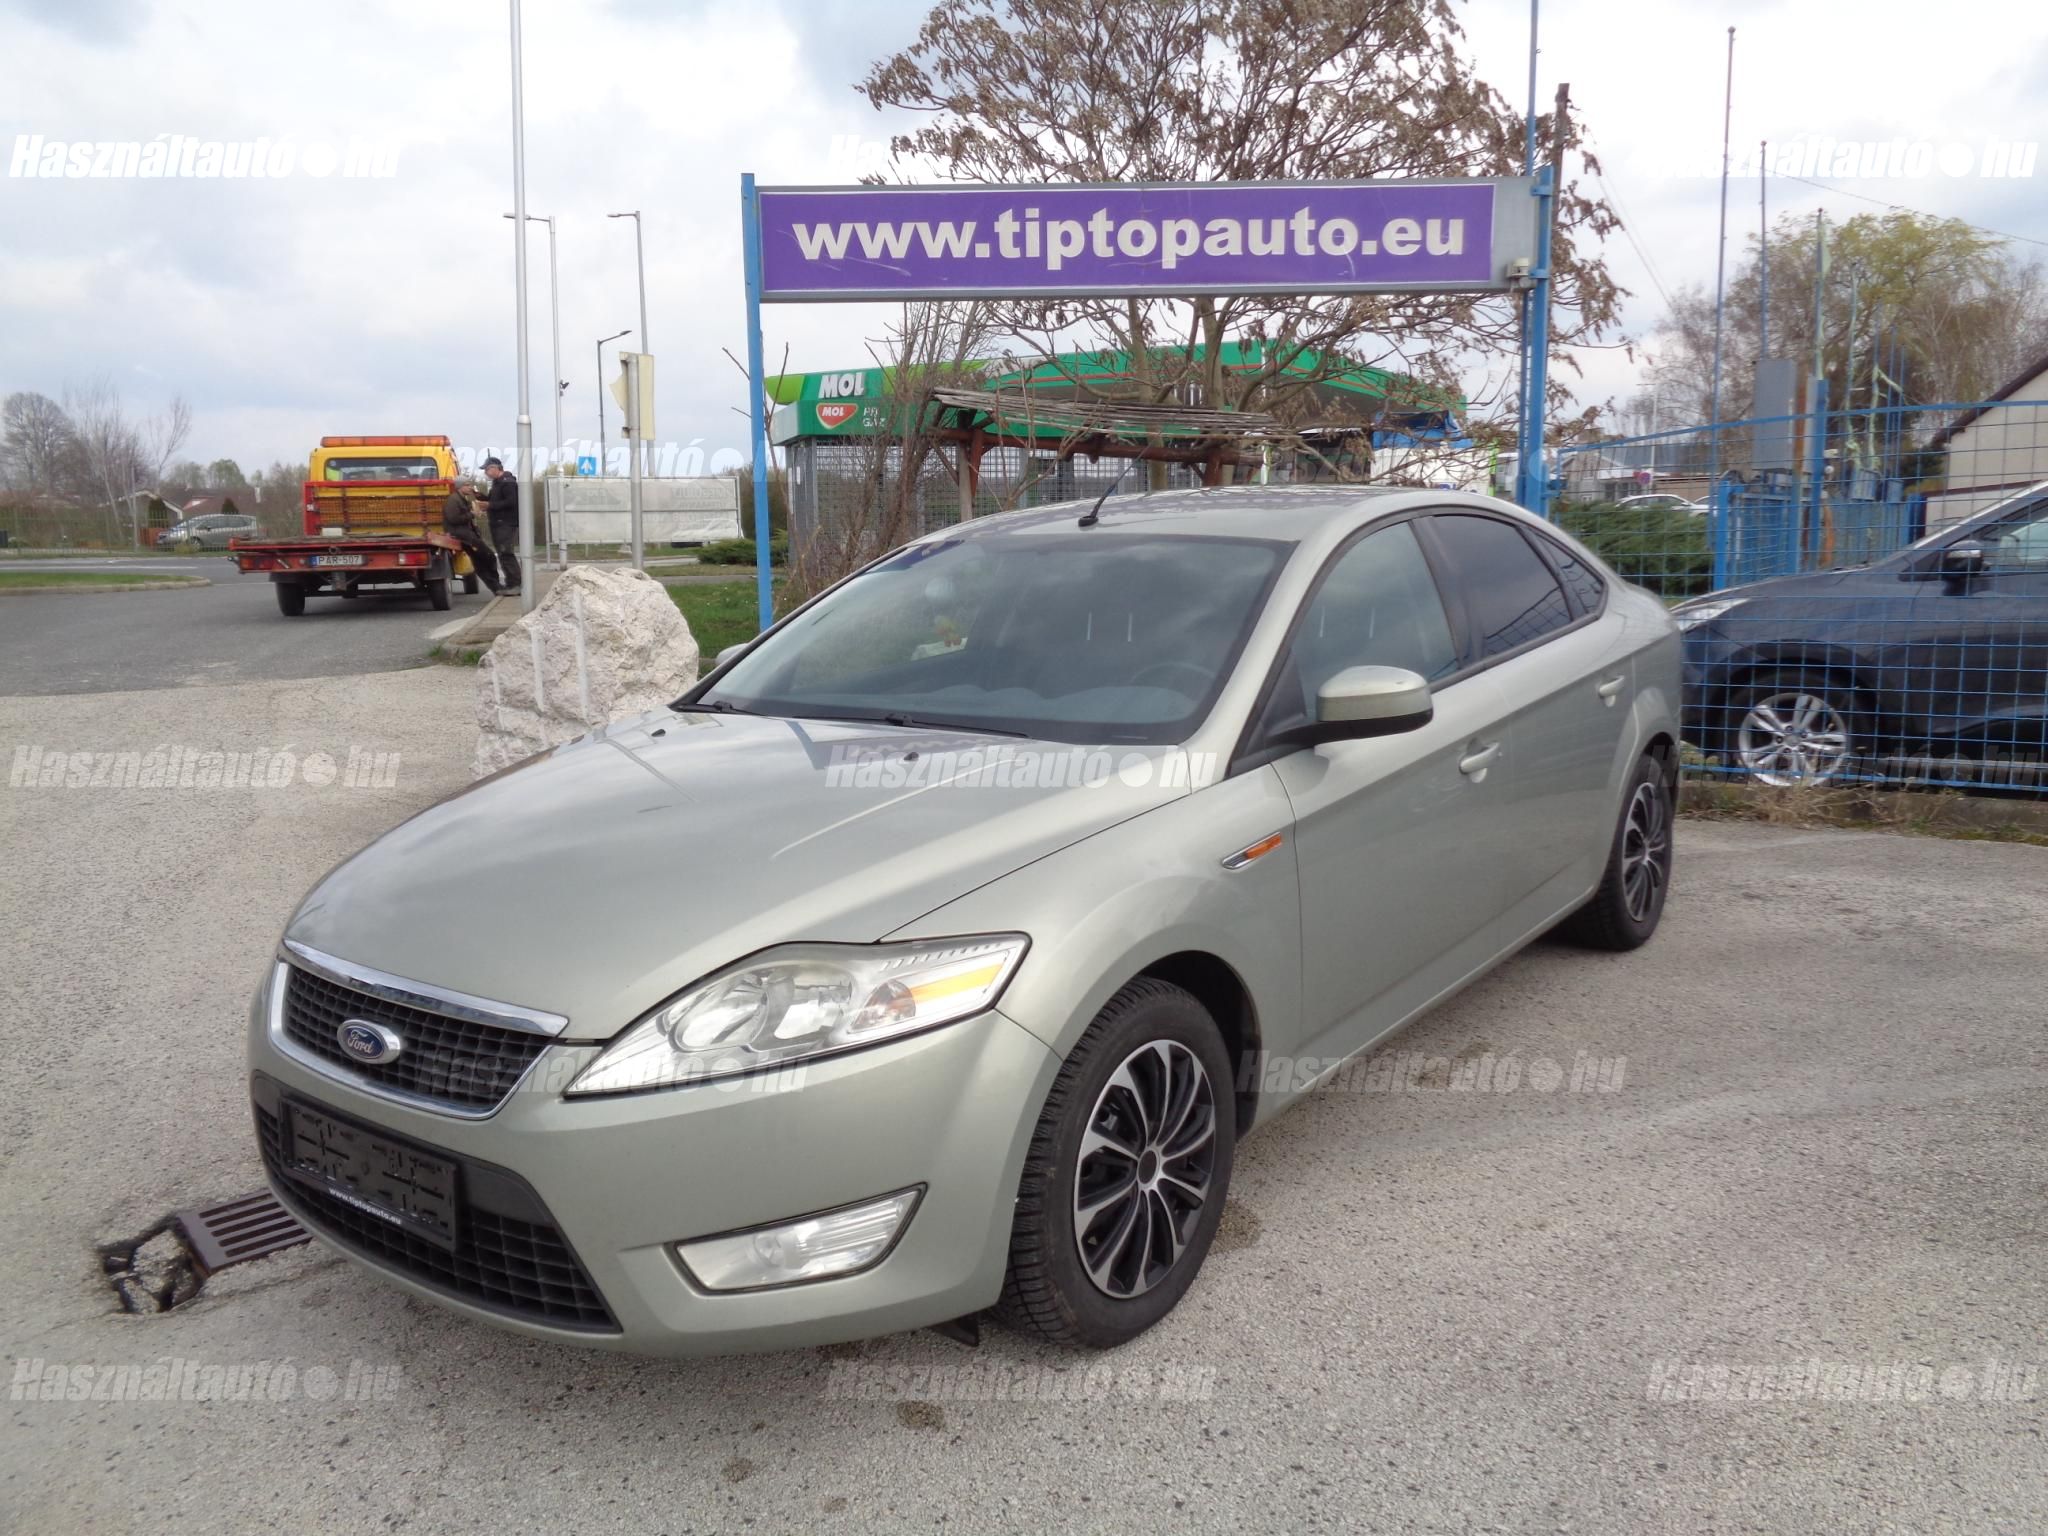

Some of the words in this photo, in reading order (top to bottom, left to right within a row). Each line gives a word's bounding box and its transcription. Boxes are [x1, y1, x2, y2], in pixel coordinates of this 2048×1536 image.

[792, 206, 1464, 271] www.tiptopauto.eu
[818, 372, 864, 398] MOL
[822, 407, 845, 417] MOL
[318, 555, 360, 566] PAR-507
[347, 1030, 376, 1054] Ford
[328, 1188, 402, 1225] www.tiptopauto.eu
